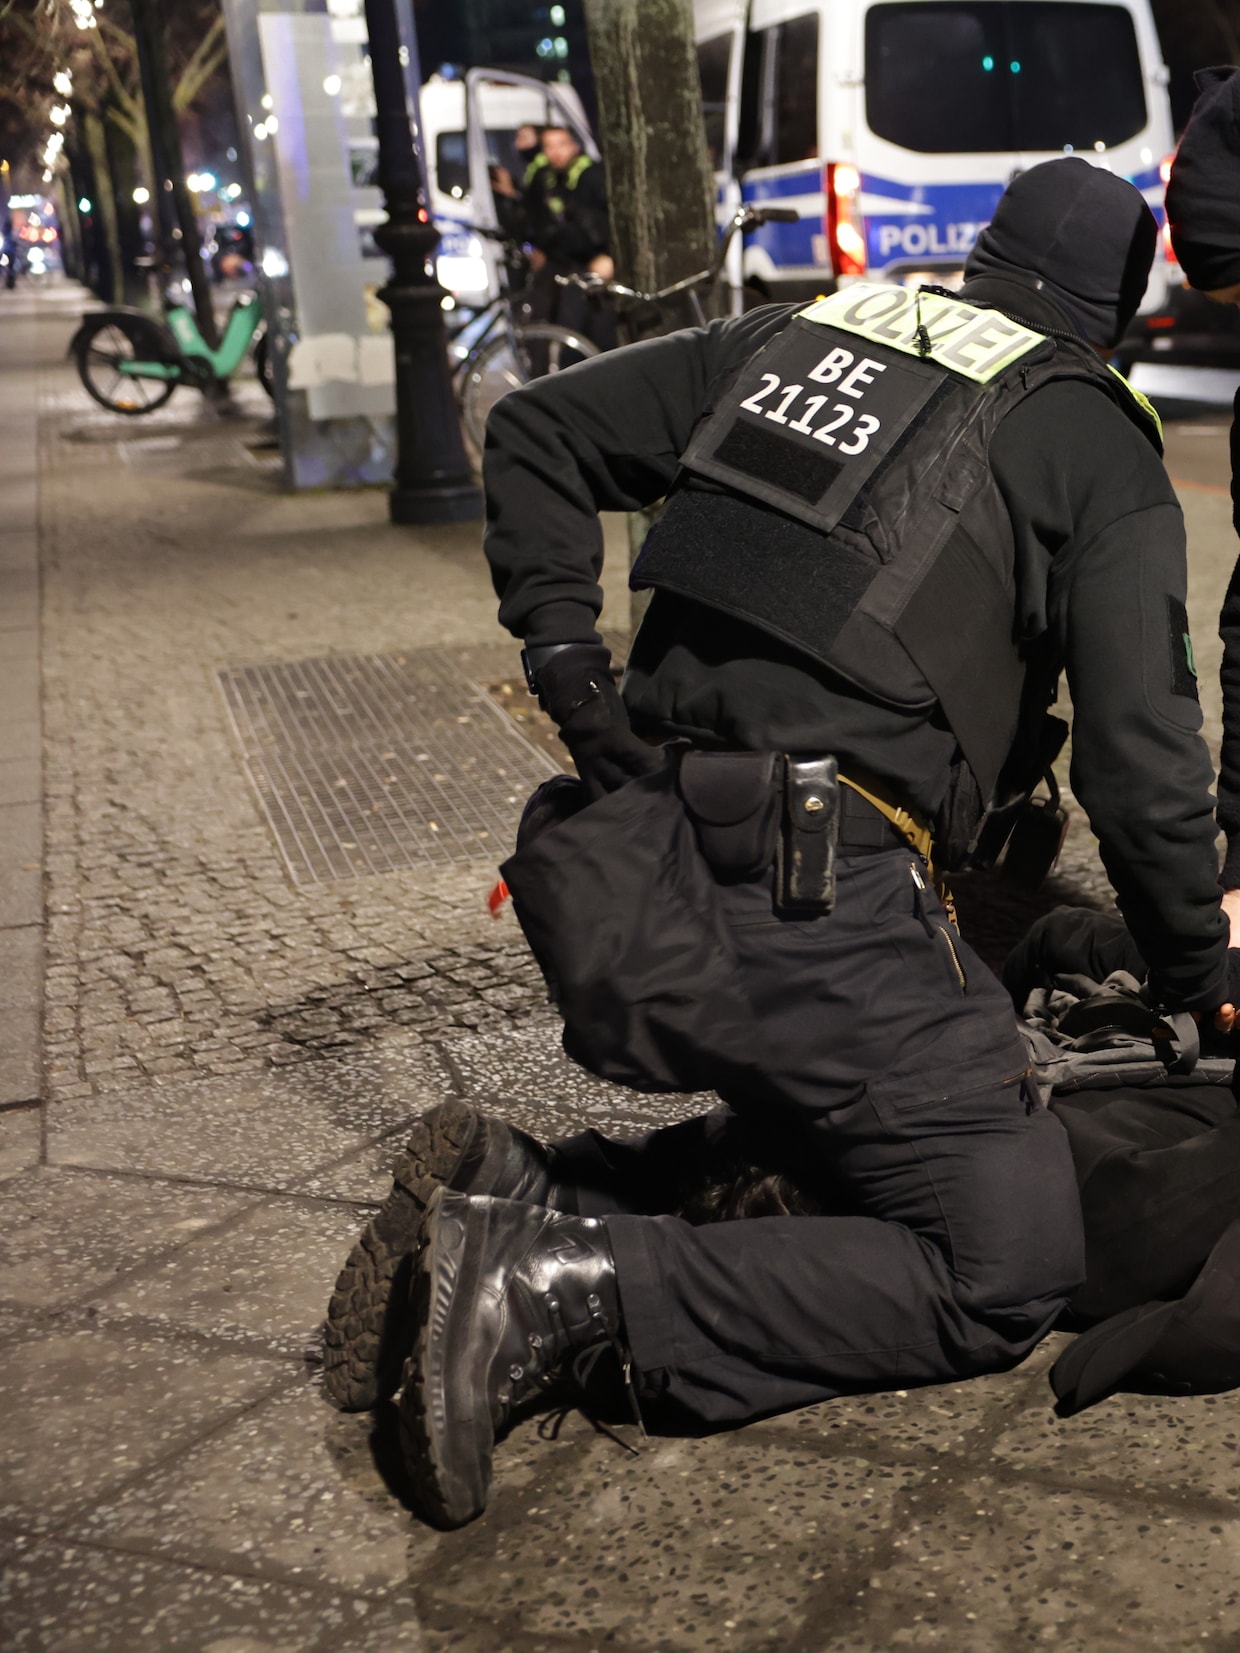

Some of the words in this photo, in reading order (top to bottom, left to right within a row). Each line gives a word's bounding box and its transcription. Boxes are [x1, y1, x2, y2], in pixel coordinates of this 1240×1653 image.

[879, 221, 991, 257] POLIZ
[806, 285, 1033, 374] OLIZEI
[807, 347, 888, 399] BE
[739, 373, 881, 455] 21123
